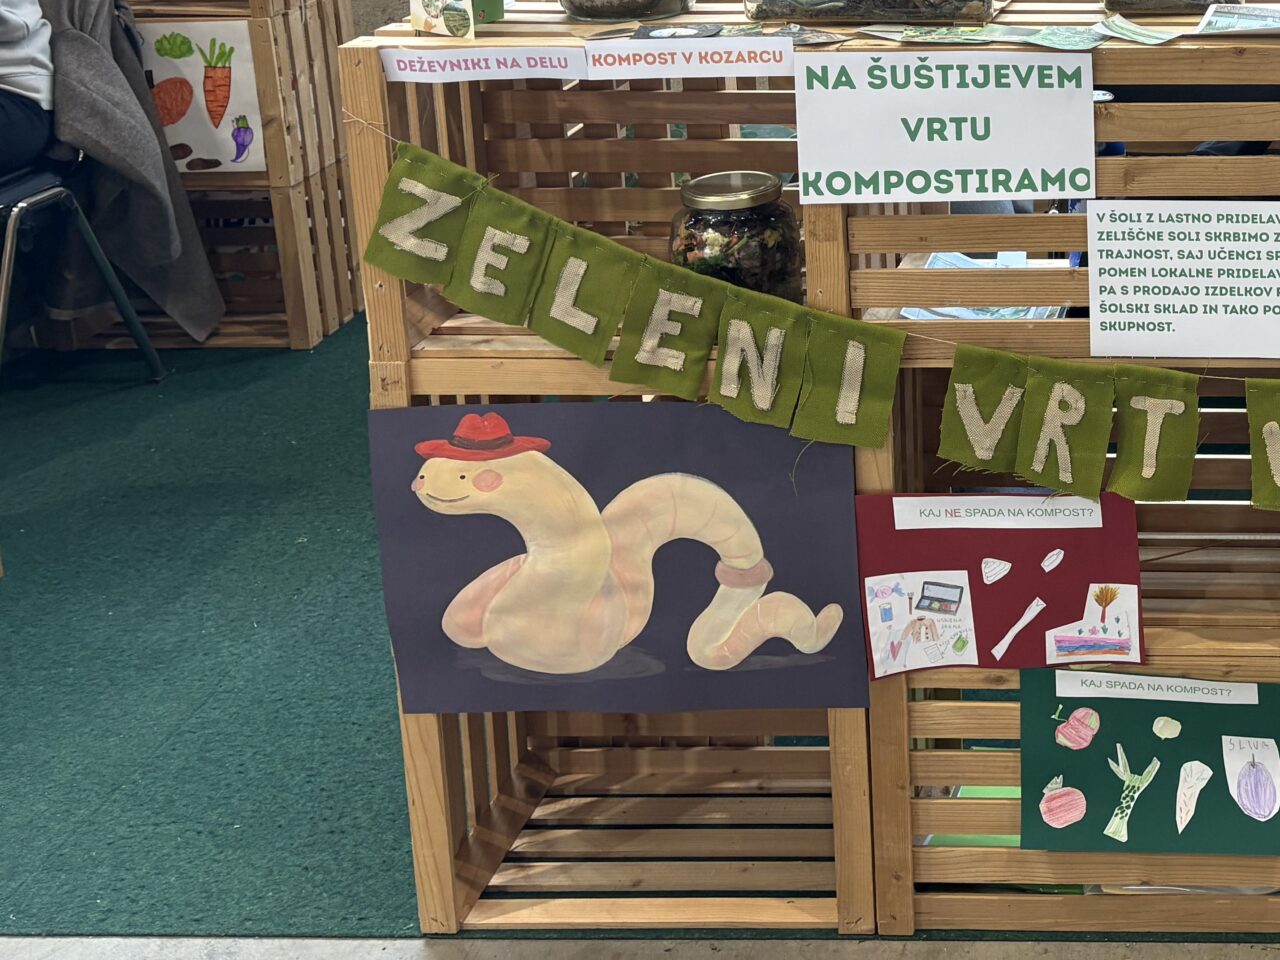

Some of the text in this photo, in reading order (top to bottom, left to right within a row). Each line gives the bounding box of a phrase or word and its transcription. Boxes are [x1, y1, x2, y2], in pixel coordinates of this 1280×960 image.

[396, 57, 568, 72] DEŽEVNIKI NA DELU
[592, 51, 783, 66] KOMPOST V KOZARCU
[806, 57, 1082, 89] NA ŠUŠTIJEVEM
[901, 117, 991, 142] VRTU
[802, 168, 1090, 196] KOMPOSTIRAMO
[1097, 213, 1105, 223] V
[1109, 212, 1142, 224] ŠOLI
[1146, 213, 1154, 223] Z
[1158, 214, 1212, 223] LASTNO
[1097, 228, 1164, 241] ZELIŠČNE
[1168, 231, 1200, 241] SOLI
[1204, 232, 1269, 242] SKRBIMO
[1098, 249, 1173, 260] TRAJNOST,
[1177, 250, 1203, 260] SAJ
[1208, 248, 1262, 261] UČENCI
[1098, 267, 1147, 277] POMEN
[1151, 268, 1213, 278] LOKALNE
[1099, 285, 1116, 295] PA
[1121, 285, 1129, 295] S
[1133, 286, 1200, 296] PRODAJO
[1204, 286, 1272, 297] IZDELKOV
[1099, 301, 1150, 314] ŠOLSKI
[1154, 303, 1198, 314] SKLAD
[1202, 304, 1218, 314] IN
[1222, 304, 1258, 315] TAKO
[379, 177, 866, 425] ZELENI
[954, 381, 1185, 483] VRT
[1100, 321, 1176, 332] SKUPNOST.
[920, 508, 1093, 518] KAJ NE SPADA NA KOMPOST?
[1081, 679, 1101, 687] KAJ
[1106, 681, 1144, 690] SPADA
[1167, 685, 1231, 696] KOMPOST?
